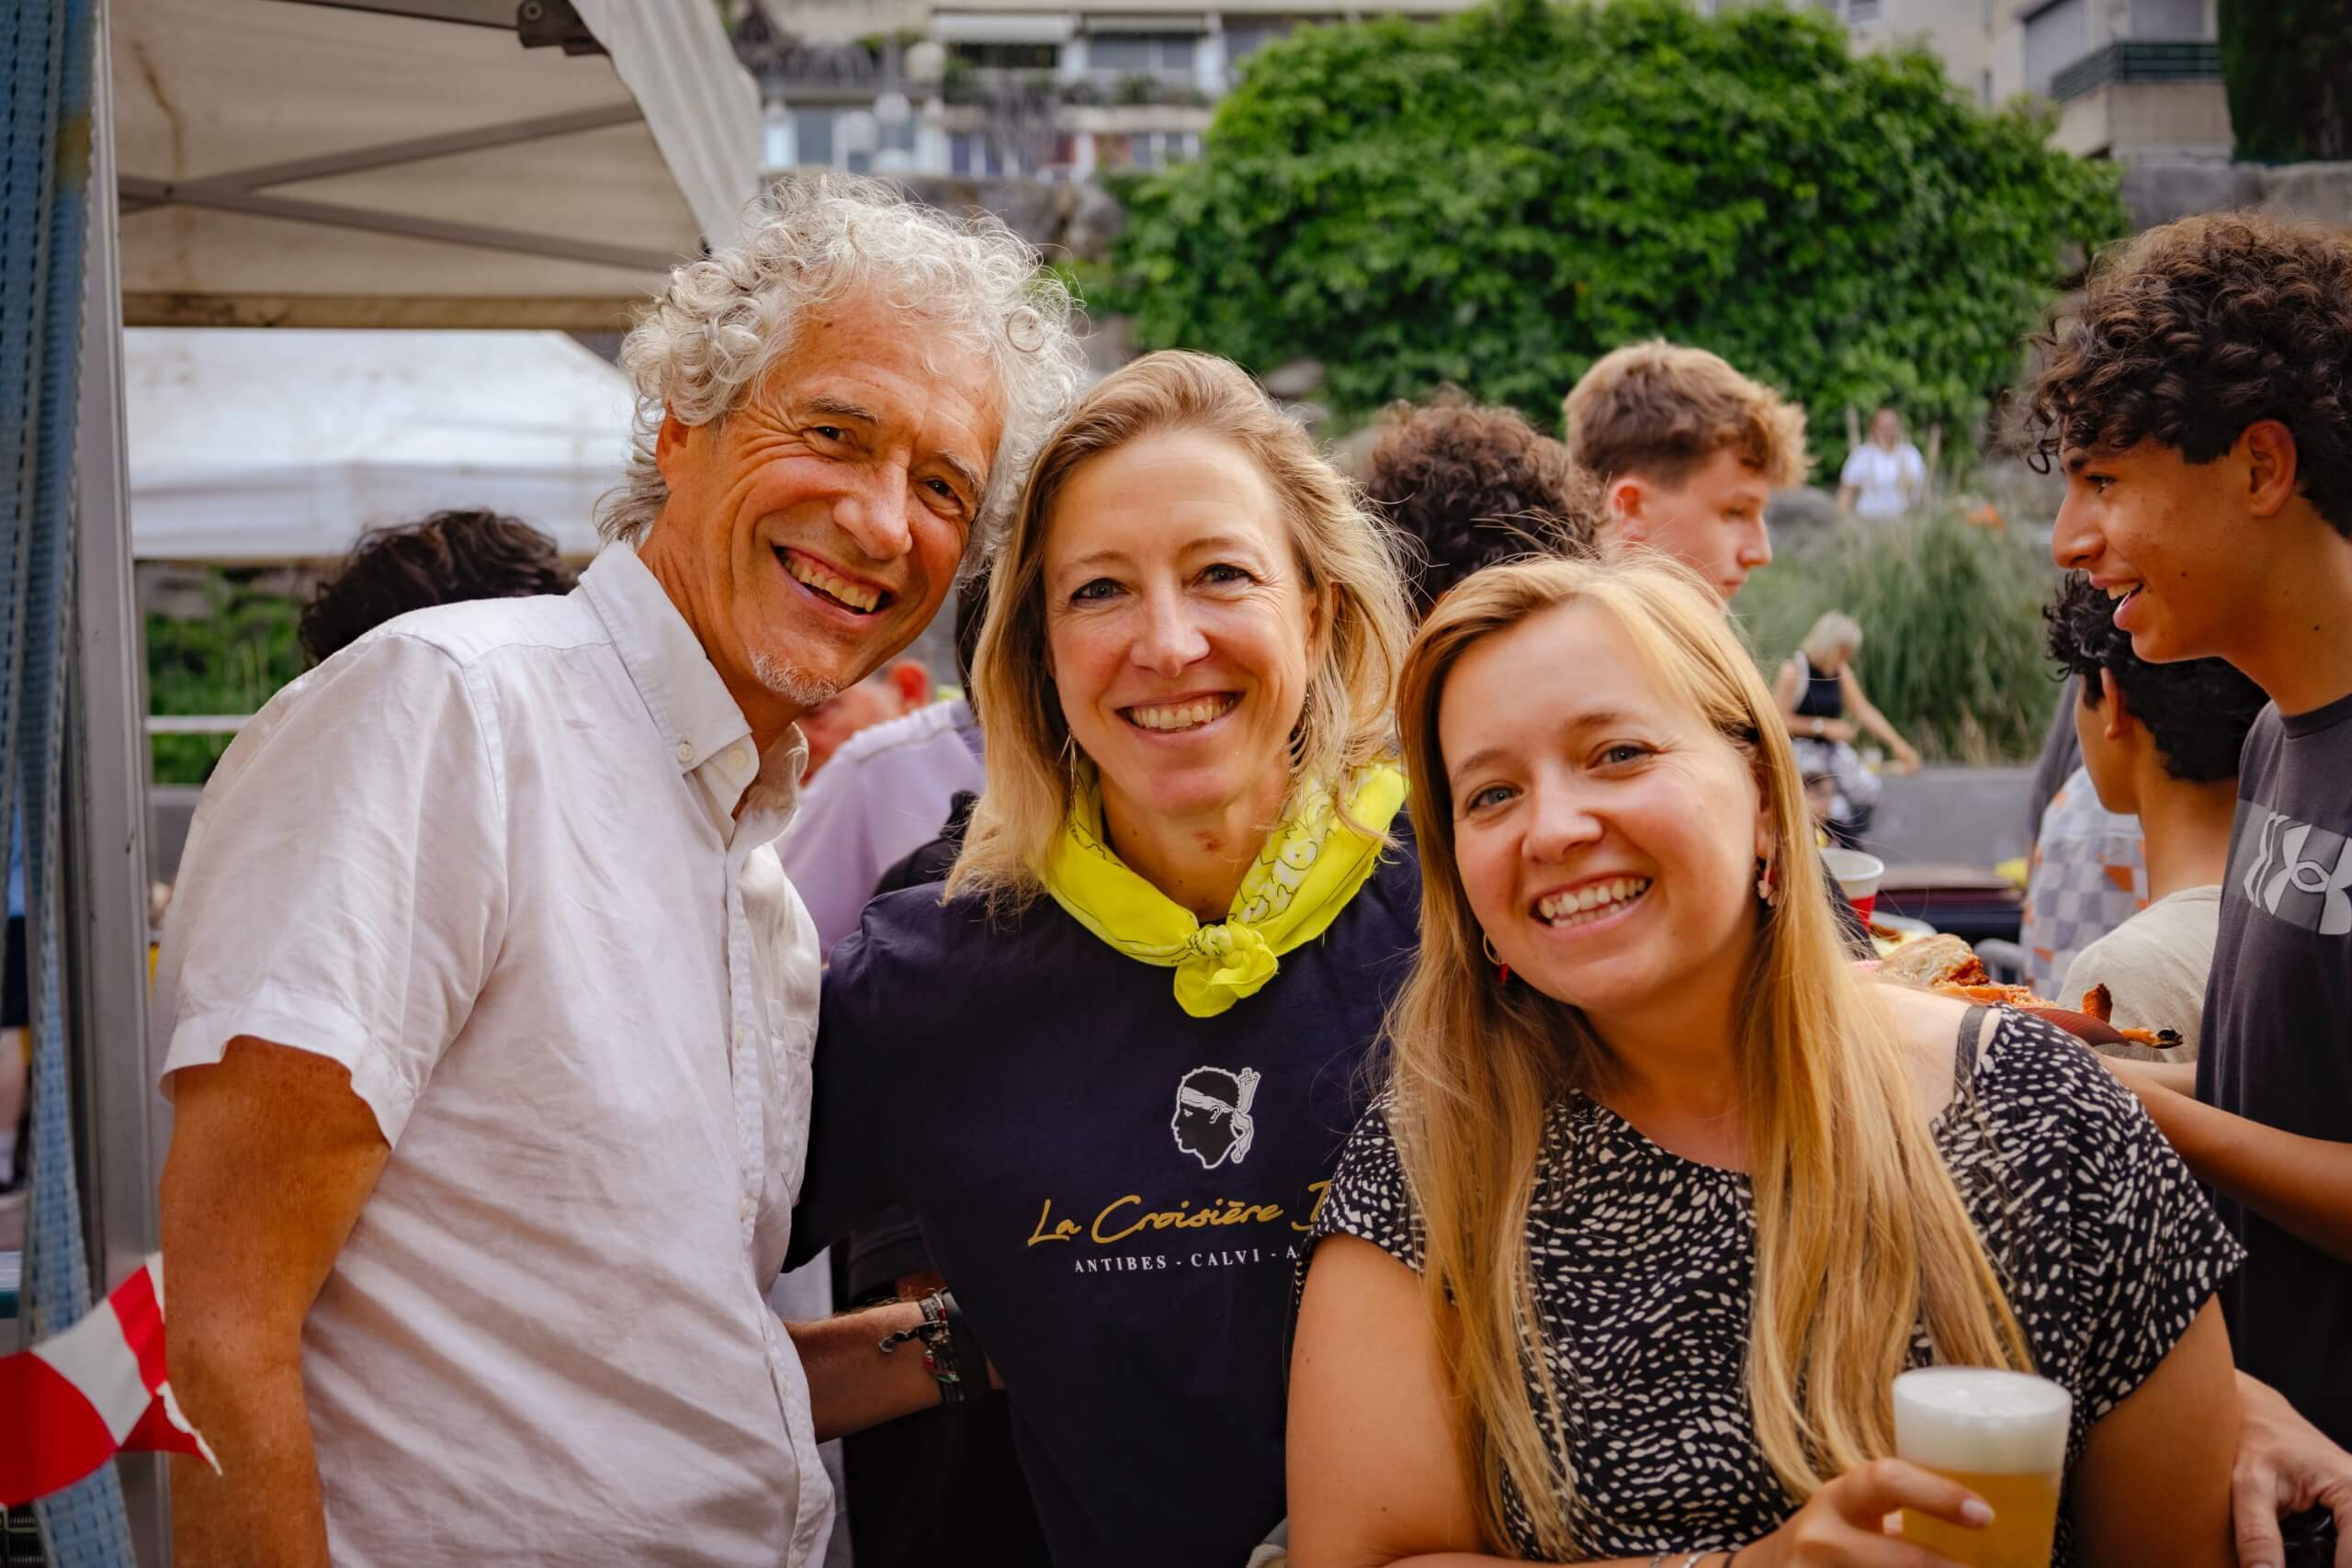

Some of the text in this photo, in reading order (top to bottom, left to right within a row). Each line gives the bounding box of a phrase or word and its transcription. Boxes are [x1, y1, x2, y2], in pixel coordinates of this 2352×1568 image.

[1027, 1198, 1082, 1247] La
[1290, 1179, 1332, 1232] J
[1074, 1255, 1167, 1273] ANTIBES
[1190, 1247, 1261, 1268] CALVI
[1285, 1245, 1298, 1259] A
